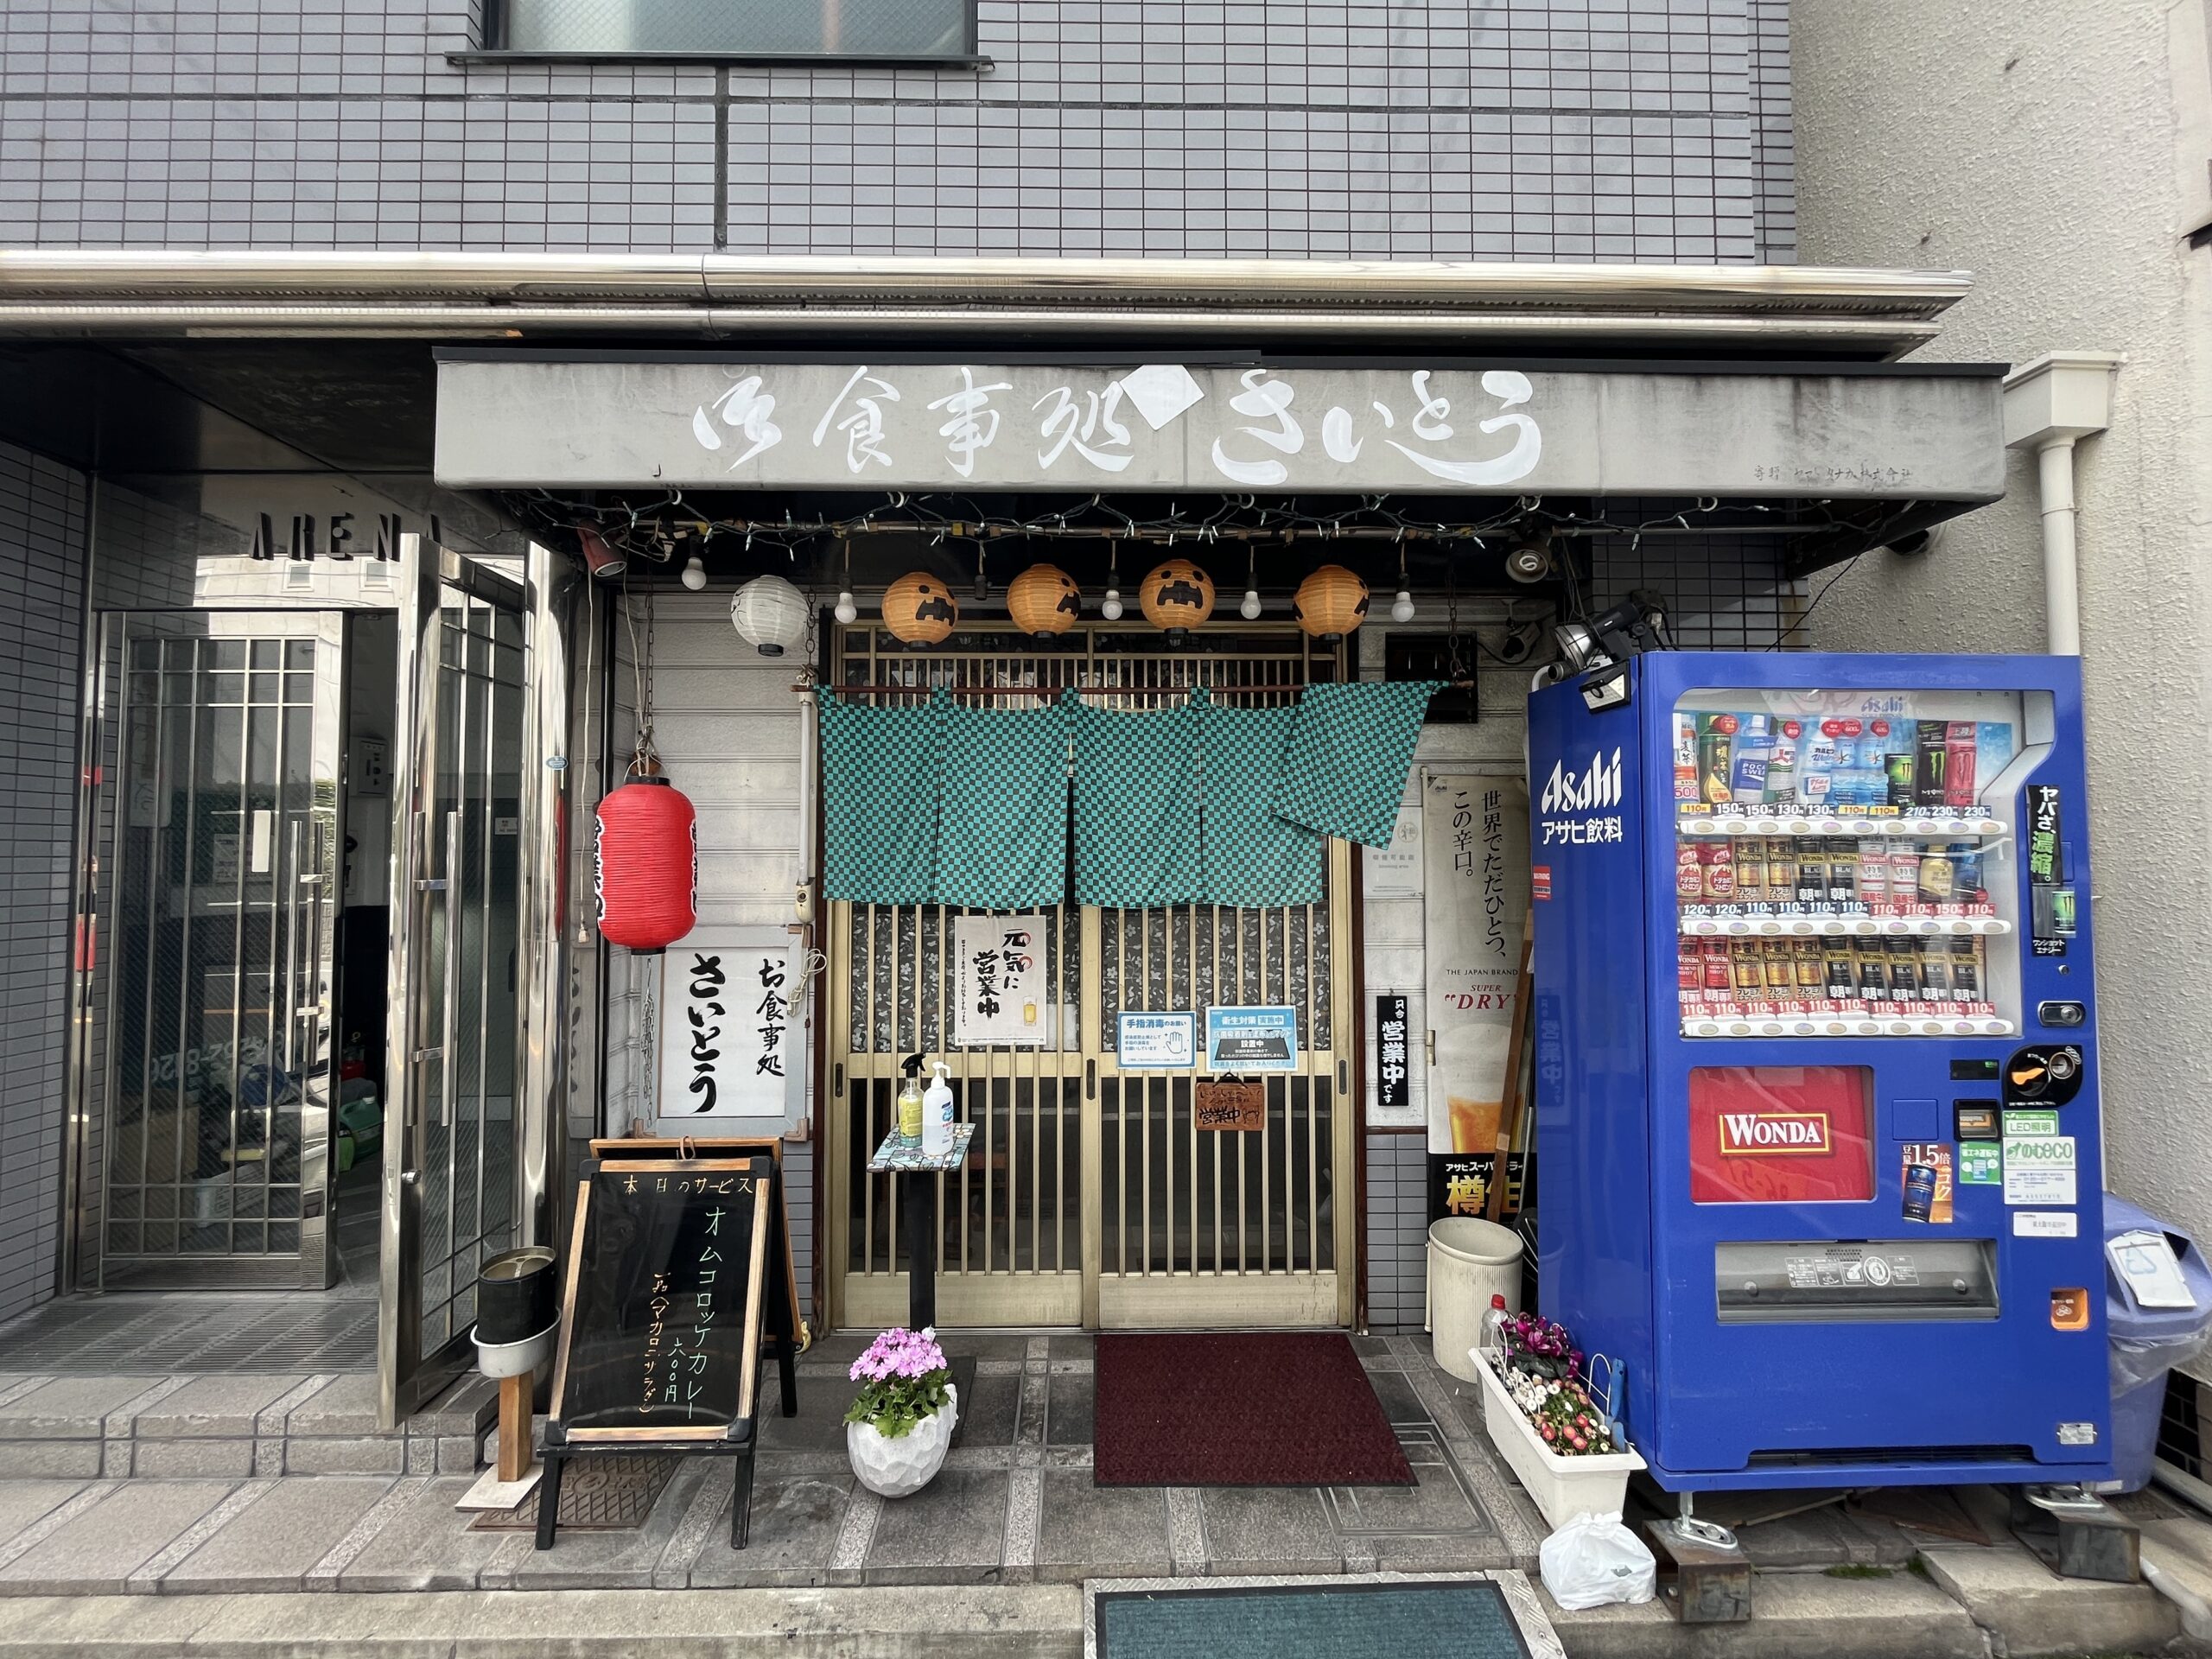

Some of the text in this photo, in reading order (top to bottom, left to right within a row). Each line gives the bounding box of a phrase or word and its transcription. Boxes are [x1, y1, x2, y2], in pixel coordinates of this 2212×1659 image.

[1211, 367, 1542, 485] さいとう
[1861, 696, 1904, 712] Asahi
[1541, 746, 1623, 815] Asahi
[1452, 791, 1473, 877] この辛口。
[1541, 817, 1623, 845] アサヒ飲料
[1482, 790, 1506, 957] 世界でただひとつ、
[972, 950, 1001, 1020] 営業中
[1001, 928, 1027, 988] 元気に
[688, 952, 726, 1115] さいとう
[756, 958, 787, 1077] お食事処
[1127, 1019, 1186, 1028] 手指消毒のお願い
[1241, 1039, 1264, 1048] 設置中
[1382, 999, 1405, 1103] 只今営業中です
[1199, 1106, 1240, 1124] 営業中
[1724, 1114, 1821, 1146] WONDA
[2011, 1122, 2050, 1132] LED照明
[624, 1174, 753, 1195] 本日のサービス
[1937, 1173, 1951, 1198] コク
[687, 1207, 726, 1419] オムコロッケカレー
